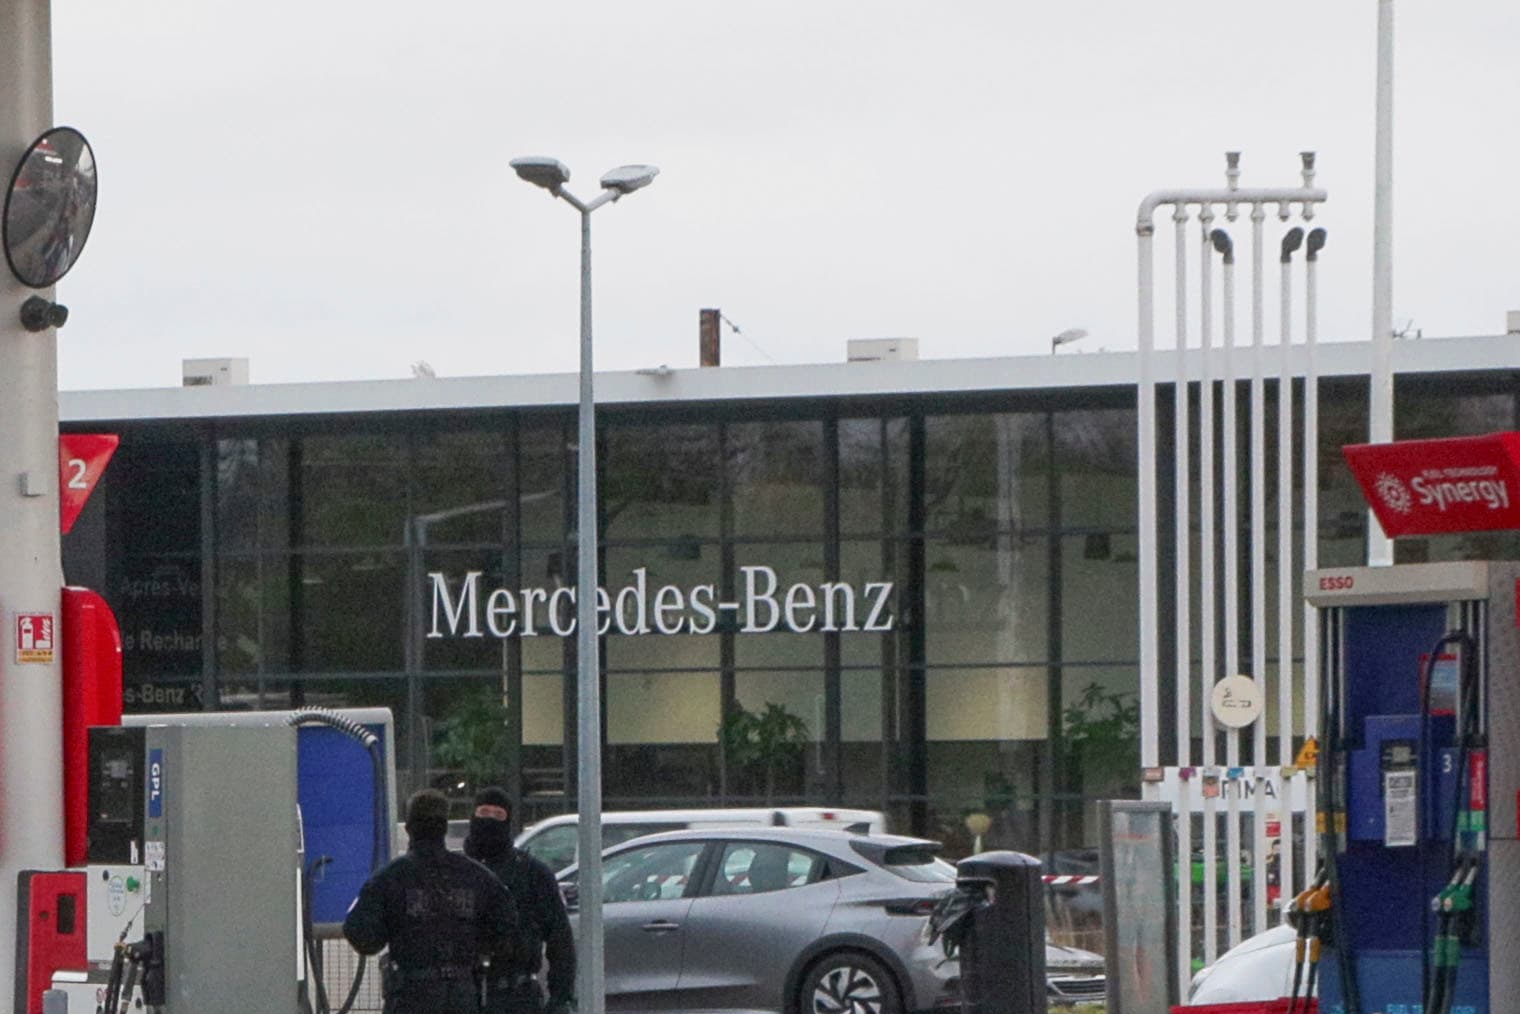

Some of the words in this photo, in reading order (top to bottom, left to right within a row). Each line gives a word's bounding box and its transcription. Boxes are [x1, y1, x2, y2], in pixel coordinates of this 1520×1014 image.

[68, 459, 88, 489] 2
[1411, 476, 1509, 511] Synergy
[1319, 576, 1354, 591] ESSO
[1442, 753, 1452, 773] 3
[151, 762, 161, 801] GPL
